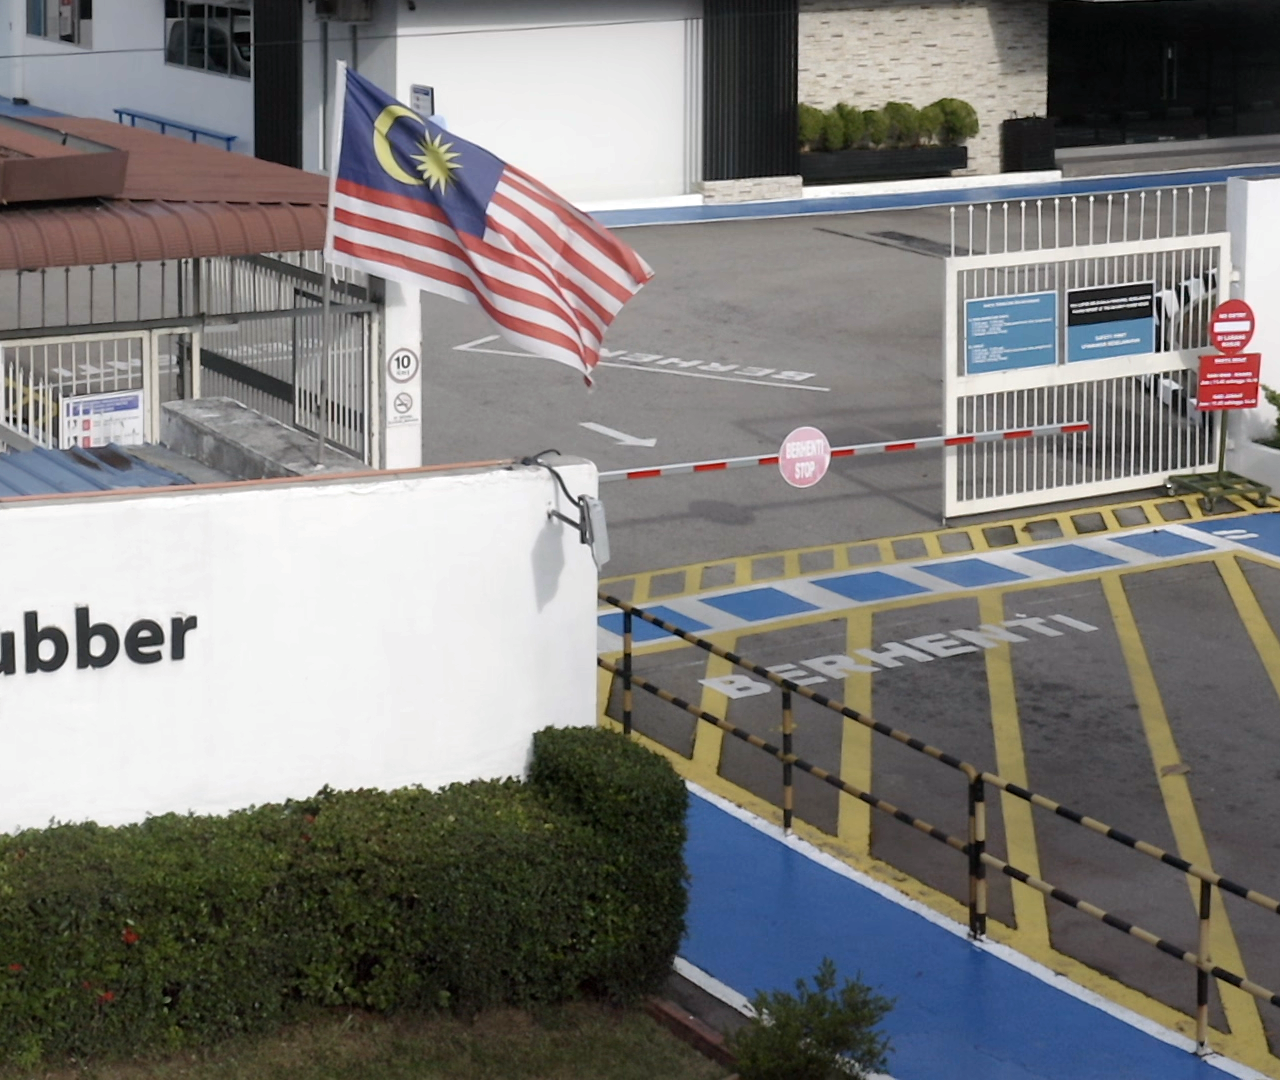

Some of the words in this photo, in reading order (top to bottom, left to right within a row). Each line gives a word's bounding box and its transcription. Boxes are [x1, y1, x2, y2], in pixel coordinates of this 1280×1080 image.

[395, 354, 411, 369] 10
[598, 347, 817, 382] BERHEN
[785, 439, 824, 460] BERHENTI
[794, 461, 816, 480] STOP
[698, 613, 1100, 700] BERHENTI
